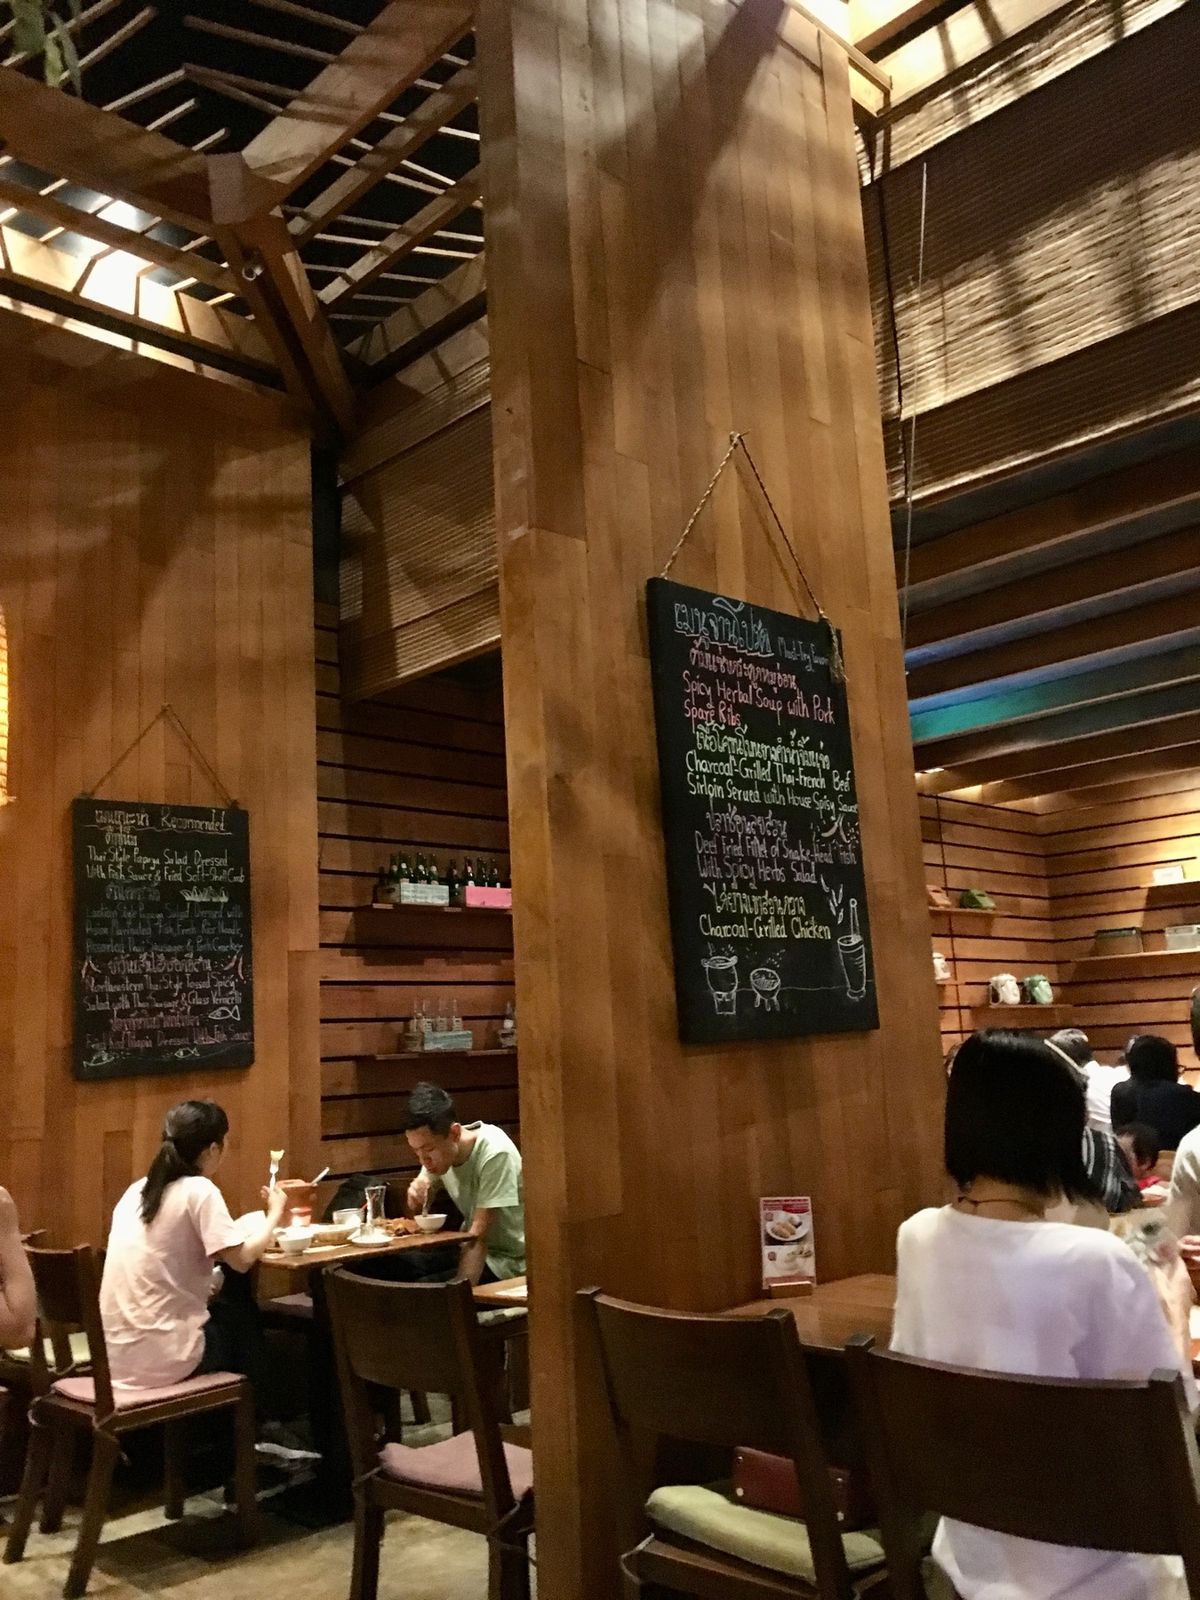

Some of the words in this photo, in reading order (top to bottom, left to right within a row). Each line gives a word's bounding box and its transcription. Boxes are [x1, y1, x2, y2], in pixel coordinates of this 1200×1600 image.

[683, 670, 714, 709] Spicy
[717, 679, 753, 705] Herbal
[756, 687, 782, 726] Soup
[788, 687, 810, 718] with
[813, 694, 836, 725] Pork
[684, 698, 715, 734] Spare
[719, 701, 741, 727] Ribs
[686, 749, 771, 782] Charcoal-Grilled
[832, 770, 851, 792] Beef
[687, 772, 724, 799] Sirloin
[727, 779, 761, 803] Served
[764, 783, 786, 805] with
[787, 787, 811, 809] House
[161, 806, 226, 831] Recommended
[163, 848, 188, 865] Salad
[722, 834, 744, 857] Fried
[770, 837, 782, 858] of
[164, 865, 183, 882] Fried
[724, 856, 757, 890] Spicy
[758, 858, 786, 882] Herbs
[791, 861, 818, 884] Salad
[699, 914, 788, 938] Charcoal-Grilled
[791, 916, 831, 939] Chicken
